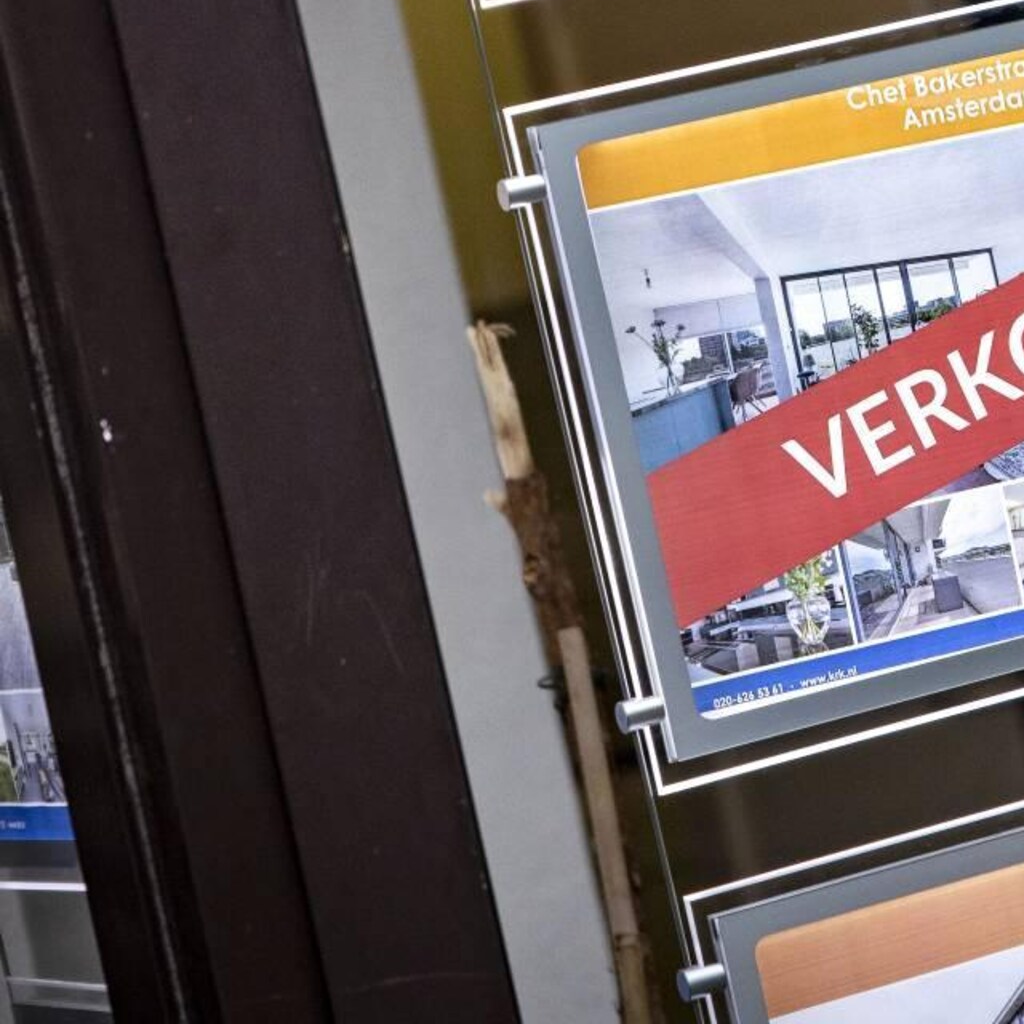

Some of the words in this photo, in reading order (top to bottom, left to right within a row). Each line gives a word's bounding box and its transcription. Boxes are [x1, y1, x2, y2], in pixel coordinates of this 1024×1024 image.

[846, 79, 907, 111] Chet
[713, 692, 754, 708] 020-626
[757, 686, 770, 698] 53
[772, 683, 784, 694] 61
[799, 665, 858, 688] www.krk.nl
